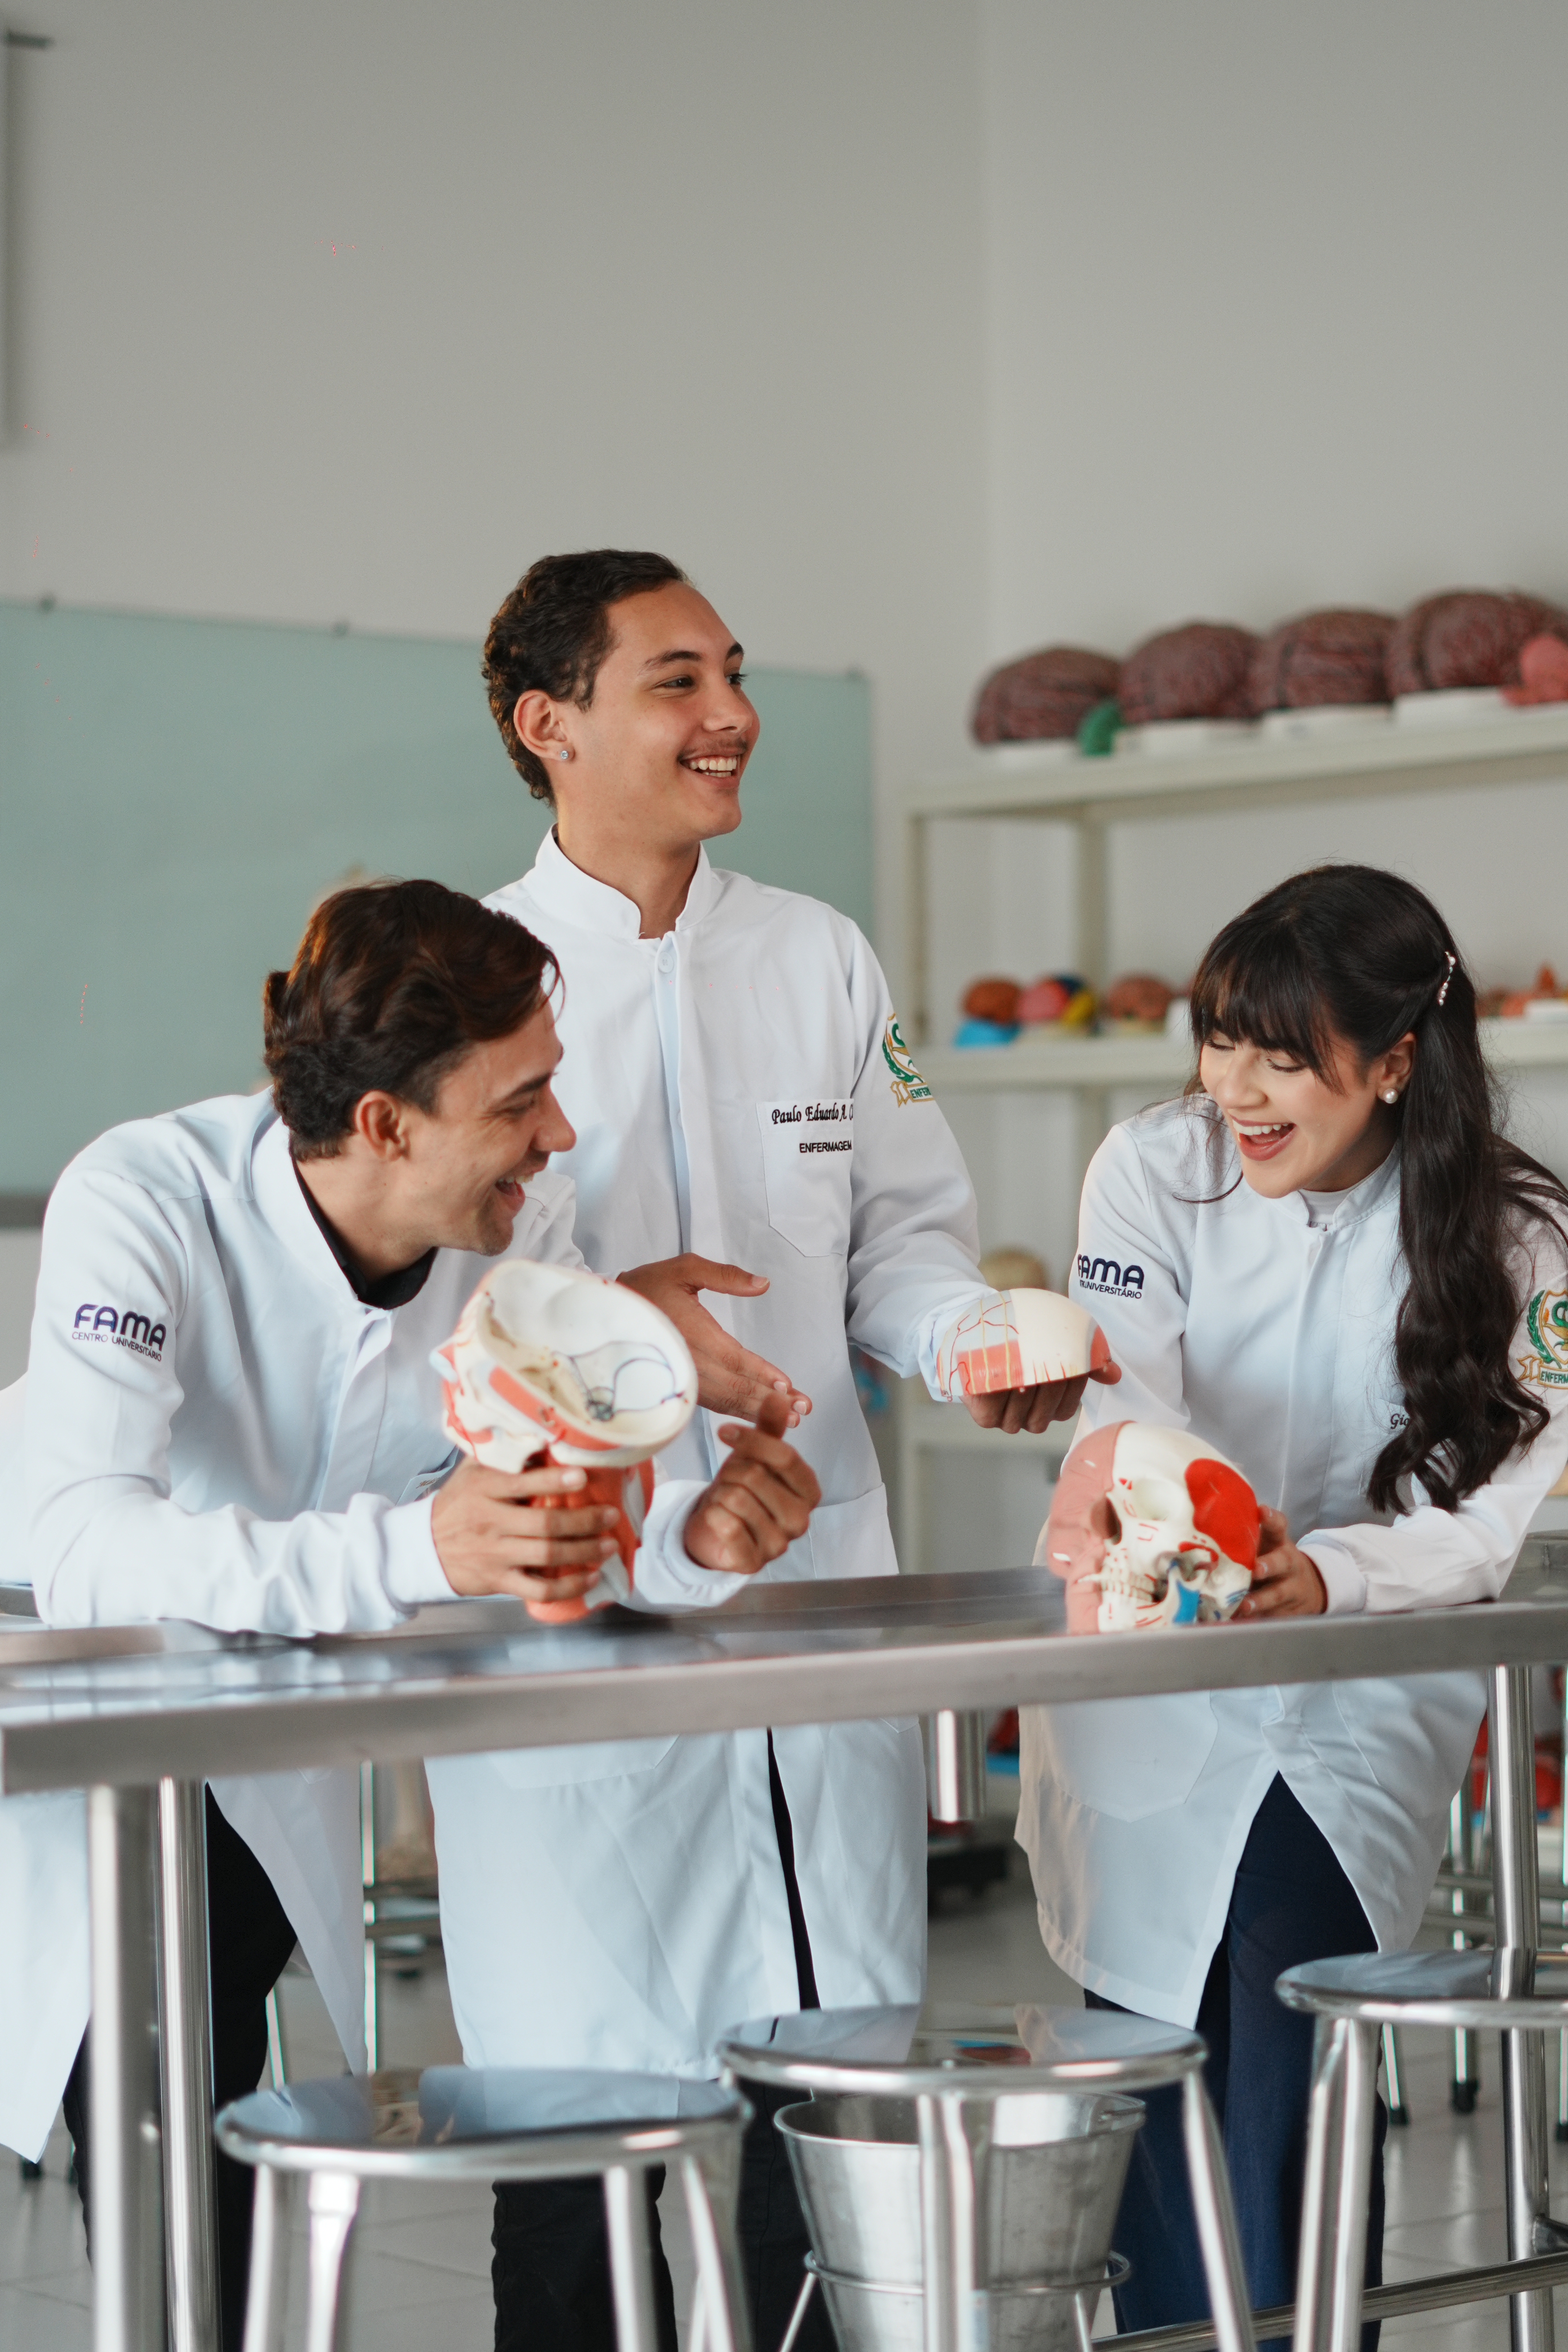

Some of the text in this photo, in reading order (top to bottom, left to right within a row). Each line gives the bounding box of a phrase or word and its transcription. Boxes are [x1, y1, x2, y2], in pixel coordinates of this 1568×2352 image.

[772, 1105, 802, 1124] Paulo
[805, 1102, 839, 1121] Eduardo
[799, 1140, 852, 1153] ENFERMAGEM
[1078, 1254, 1144, 1290] FAMA
[74, 1303, 167, 1351] FAMA
[72, 1331, 162, 1362] CENTRO UNIVERSITÁRIO
